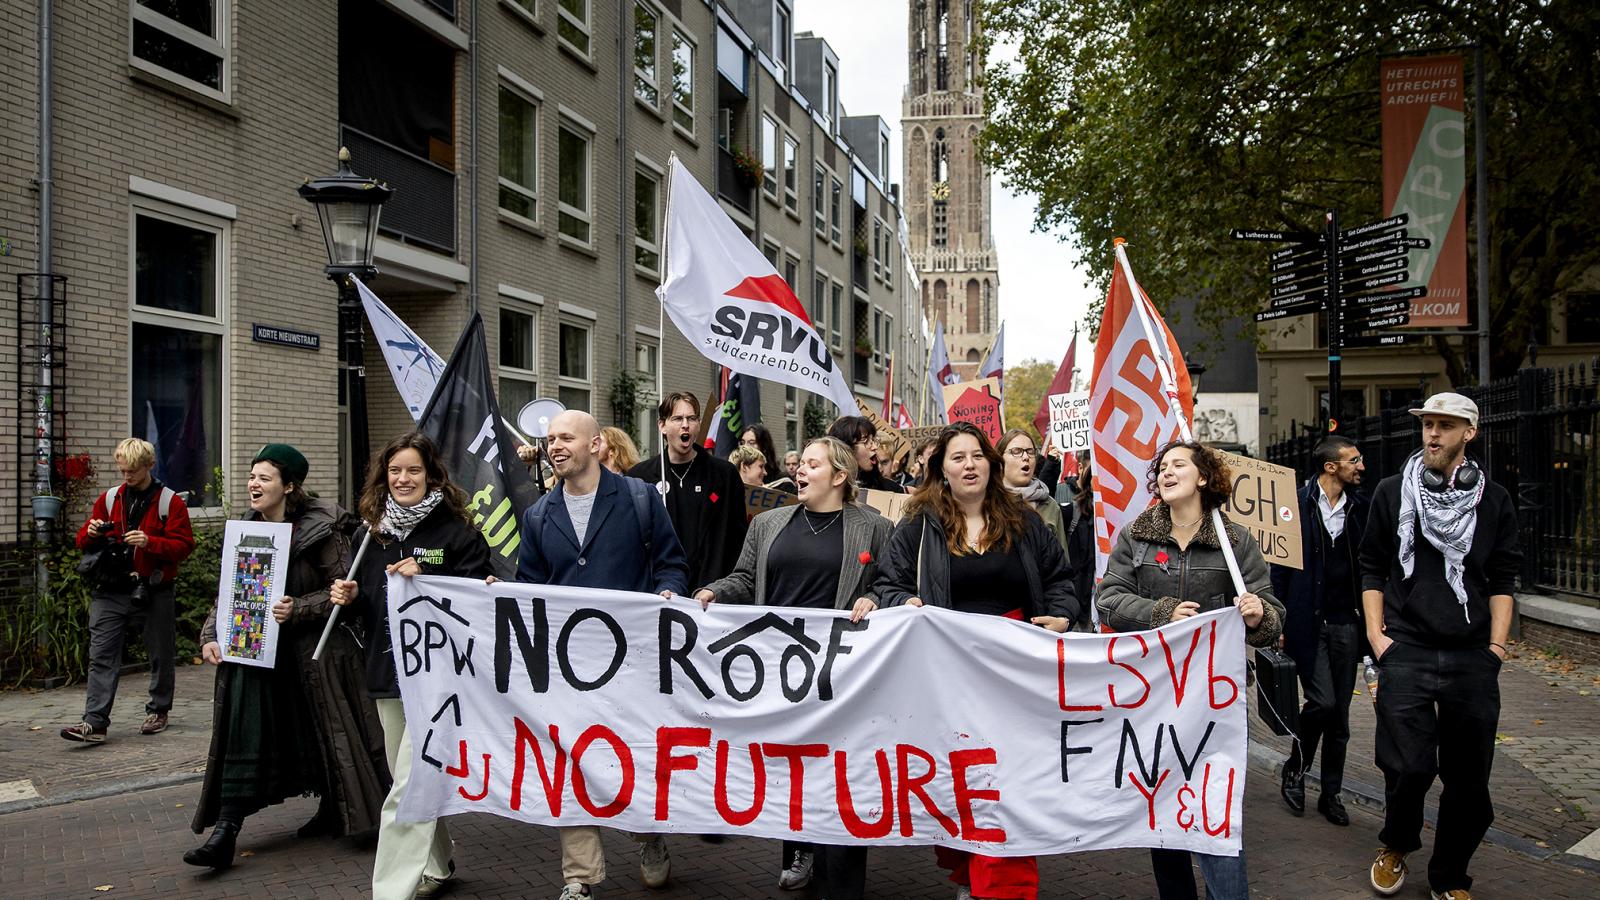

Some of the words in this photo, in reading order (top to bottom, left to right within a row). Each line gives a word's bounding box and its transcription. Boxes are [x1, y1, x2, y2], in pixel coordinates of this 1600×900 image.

[1386, 68, 1415, 79] HET
[1386, 78, 1457, 92] UTRECHTS
[1387, 92, 1448, 104] ARCHIEF
[1379, 262, 1397, 270] Museum
[1409, 302, 1461, 316] ELKOM
[257, 327, 278, 340] KORTE
[278, 331, 318, 346] NIEUWSTRAAT
[710, 305, 833, 373] SRVU
[1050, 396, 1070, 409] We
[1073, 398, 1090, 407] can
[1053, 407, 1080, 421] LIVE
[1061, 429, 1090, 449] LIST
[234, 600, 250, 610] GAME
[399, 618, 477, 679] BPW
[493, 596, 628, 695] NO
[658, 607, 870, 703] ROOF
[1056, 619, 1239, 712] LSVb
[1060, 717, 1217, 789] FNV
[510, 716, 636, 819] NO
[654, 726, 1007, 844] FUTURE
[1128, 762, 1236, 840] Y&U
